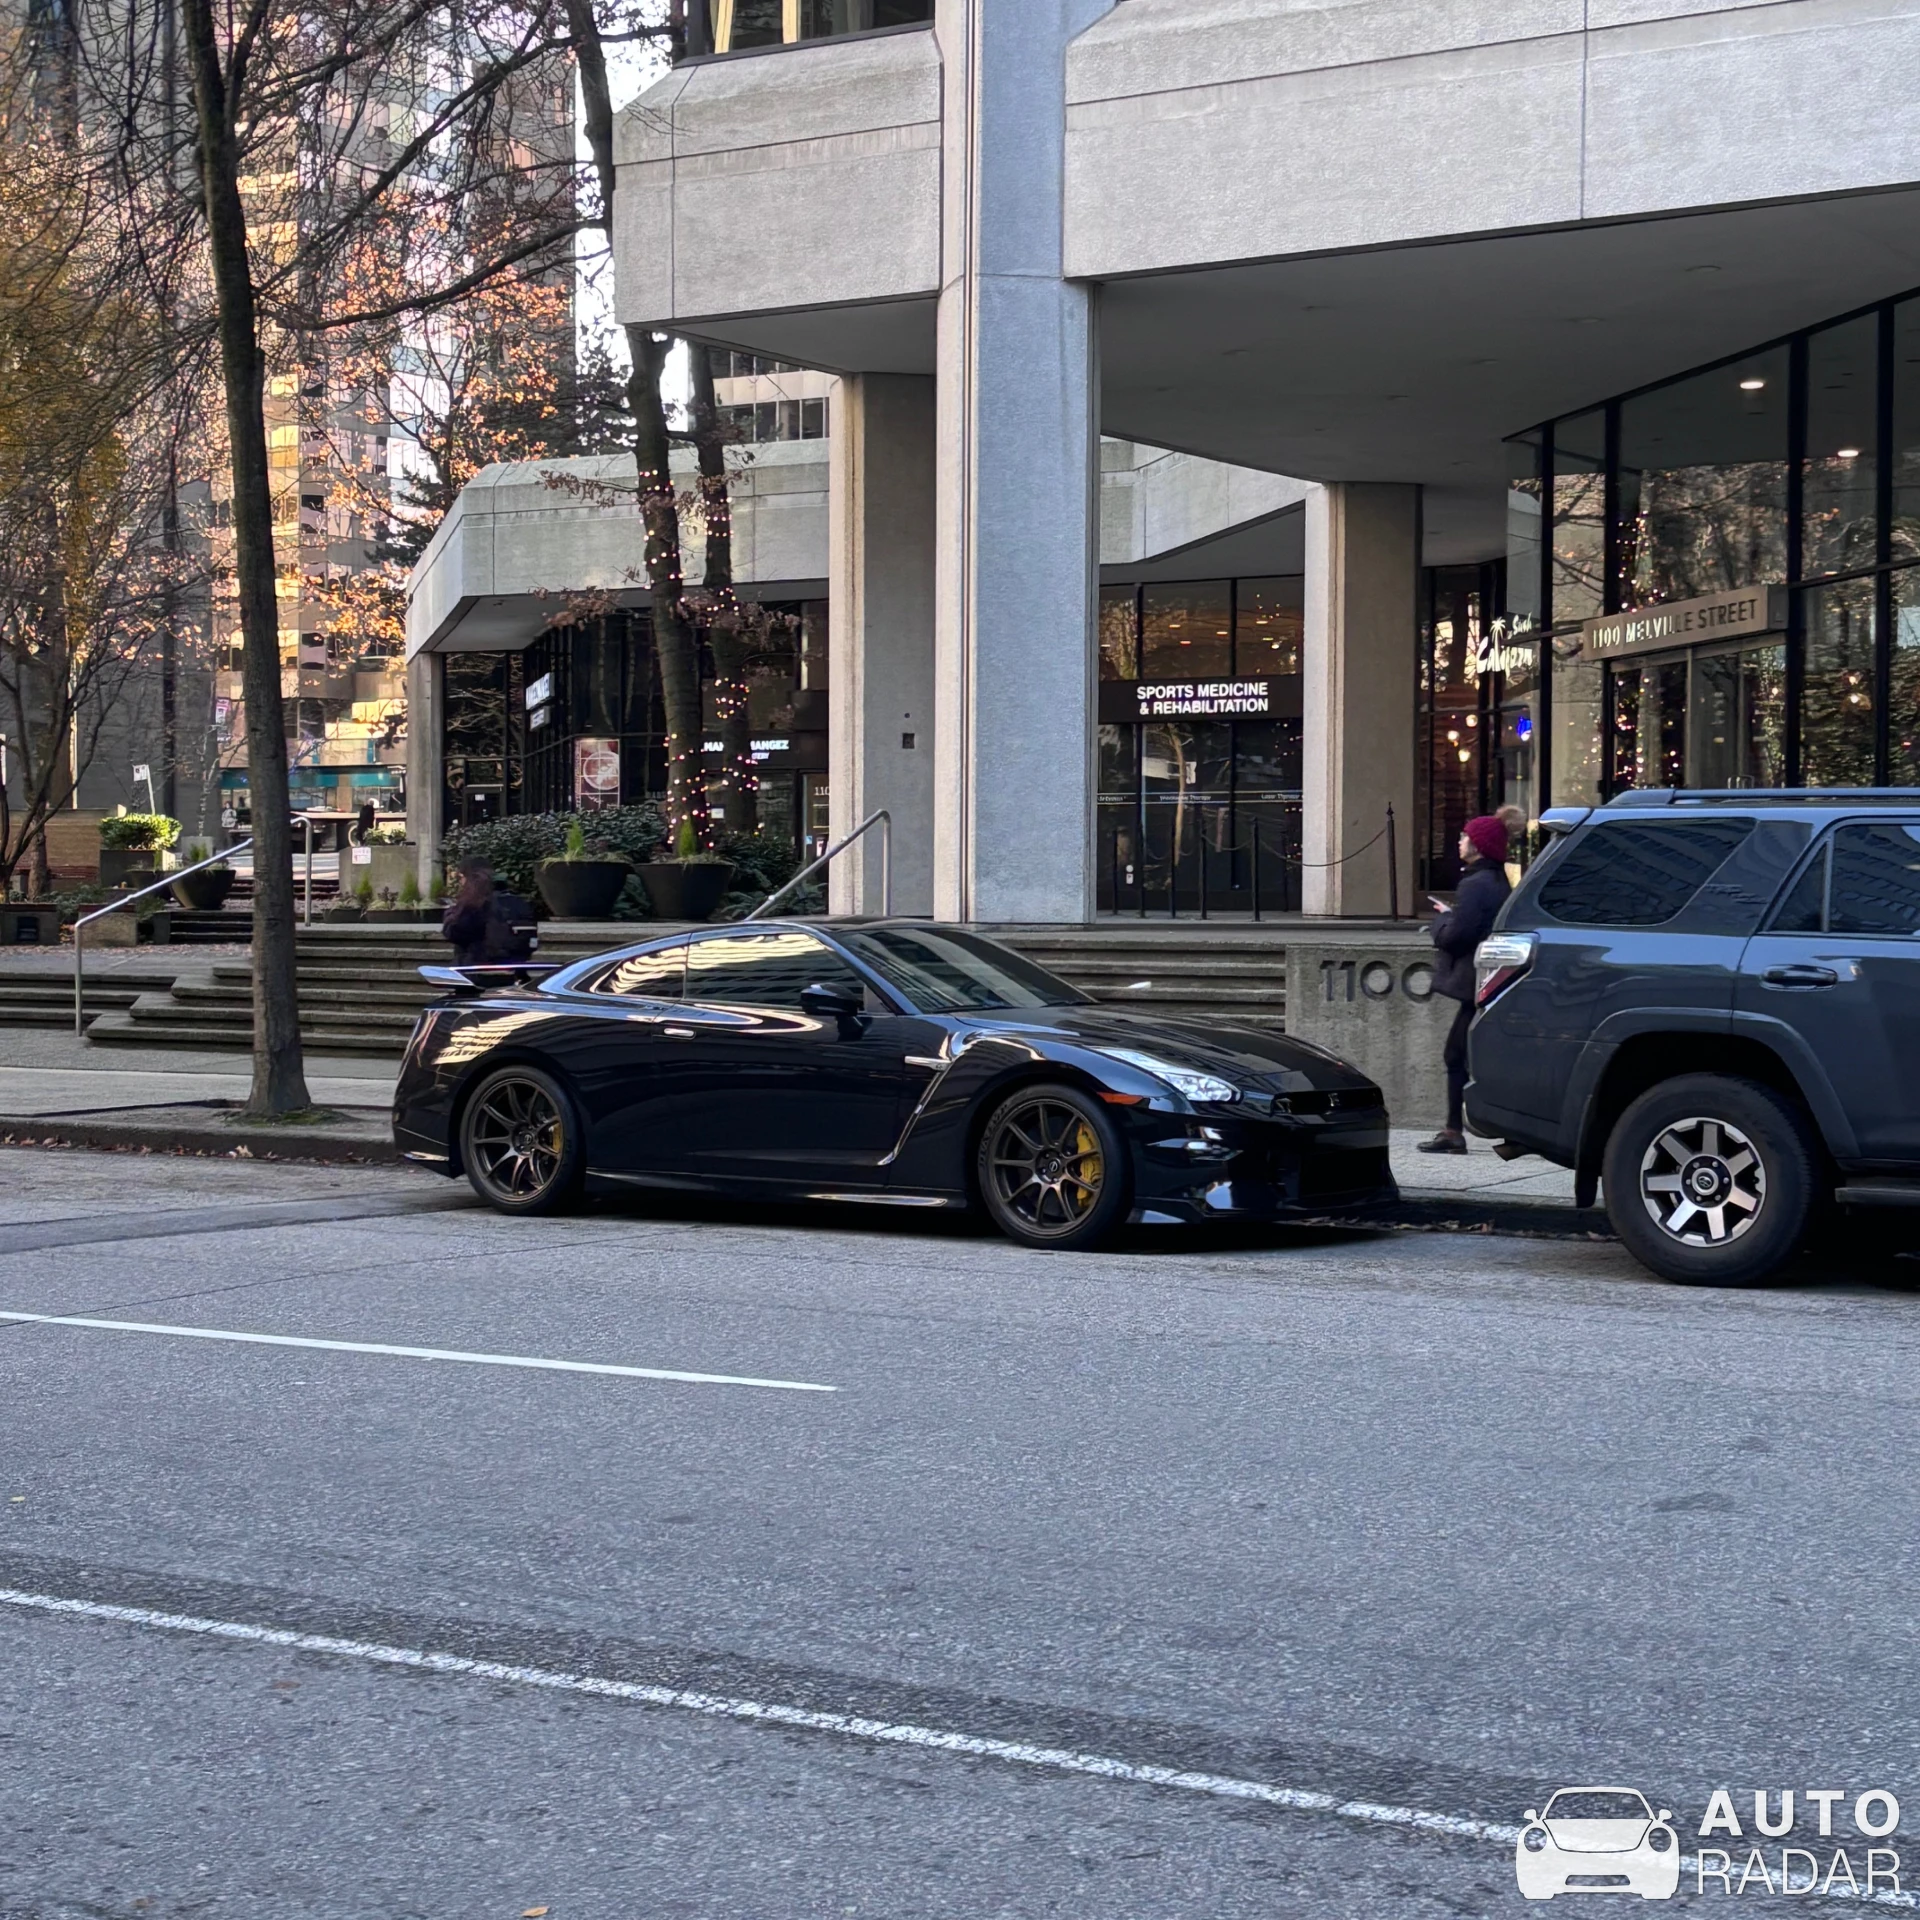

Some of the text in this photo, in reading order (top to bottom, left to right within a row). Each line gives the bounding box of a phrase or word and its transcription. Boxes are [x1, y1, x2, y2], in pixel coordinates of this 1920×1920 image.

[1593, 599, 1758, 648] 1100 MELVILLE STREET
[1137, 682, 1268, 699] SPORTS MEDICINE
[1140, 698, 1268, 715] & REHABILITATION
[1319, 960, 1437, 1004] 1100
